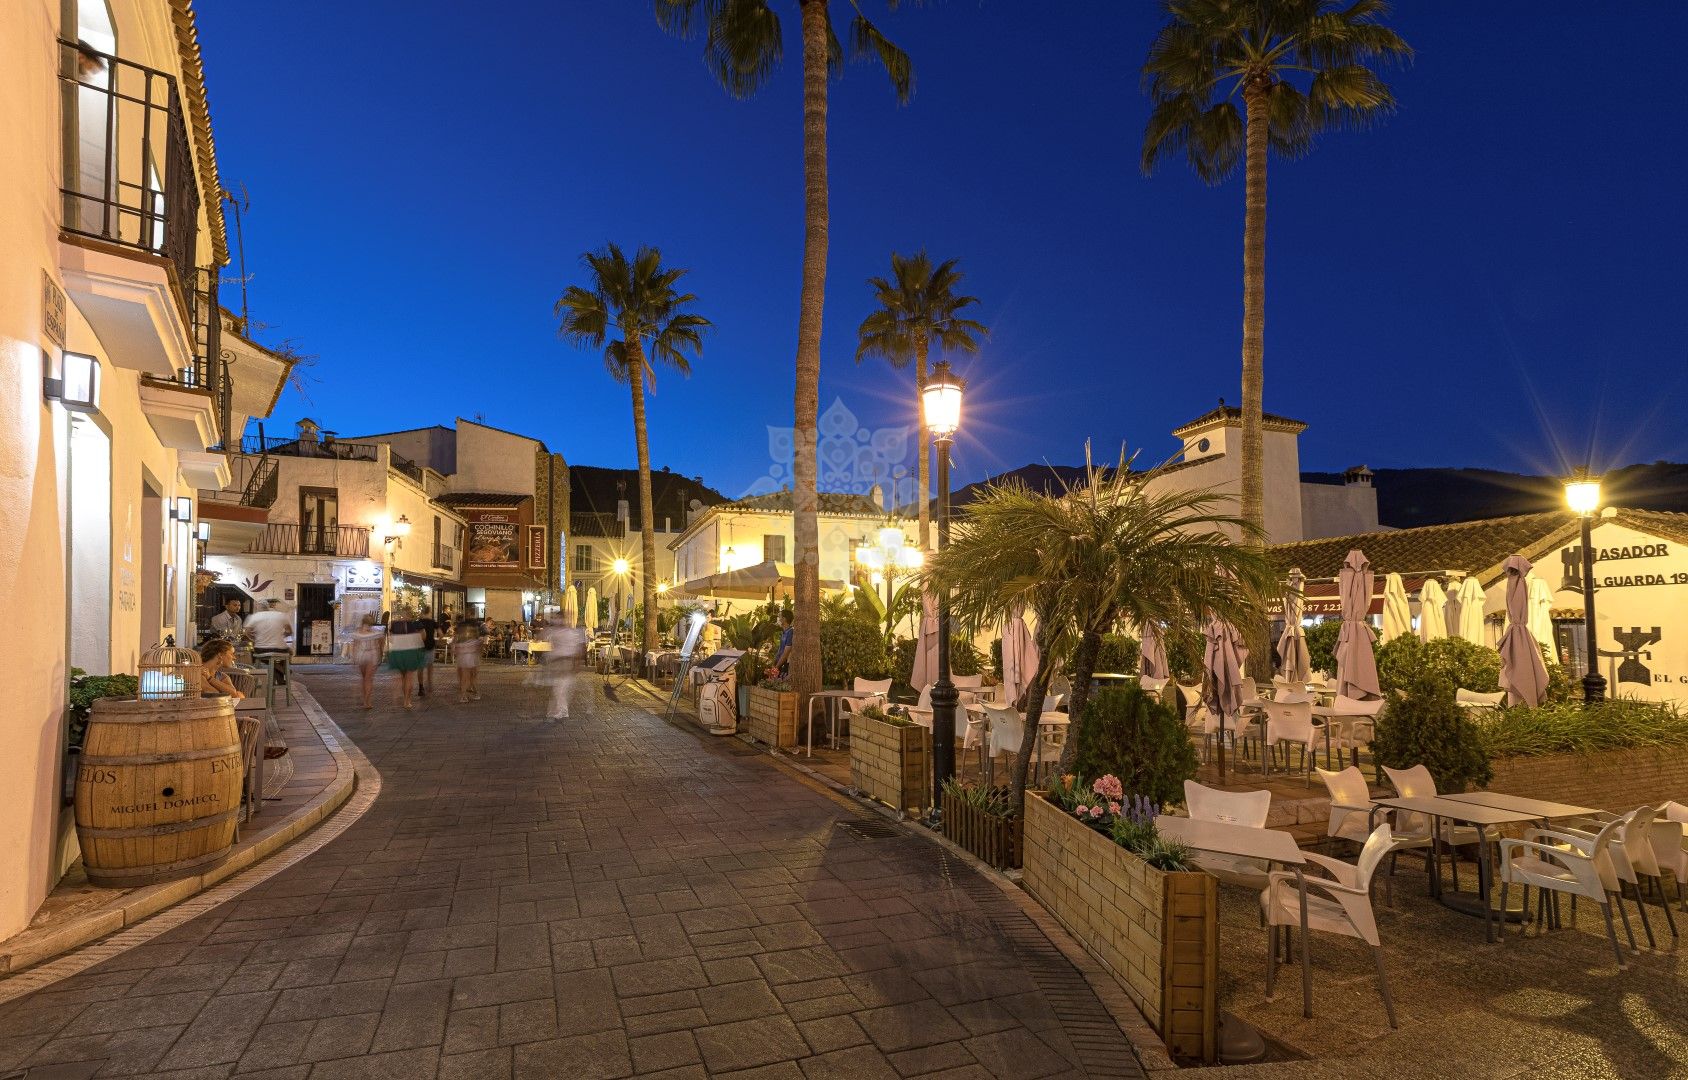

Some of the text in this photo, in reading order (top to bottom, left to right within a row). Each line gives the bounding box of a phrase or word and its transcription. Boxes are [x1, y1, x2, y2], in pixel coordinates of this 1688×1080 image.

[1599, 543, 1670, 561] ASADOR
[1604, 574, 1667, 587] GUARDA
[1654, 674, 1673, 683] EL
[110, 793, 220, 815] MIGUEL DOMECQ
